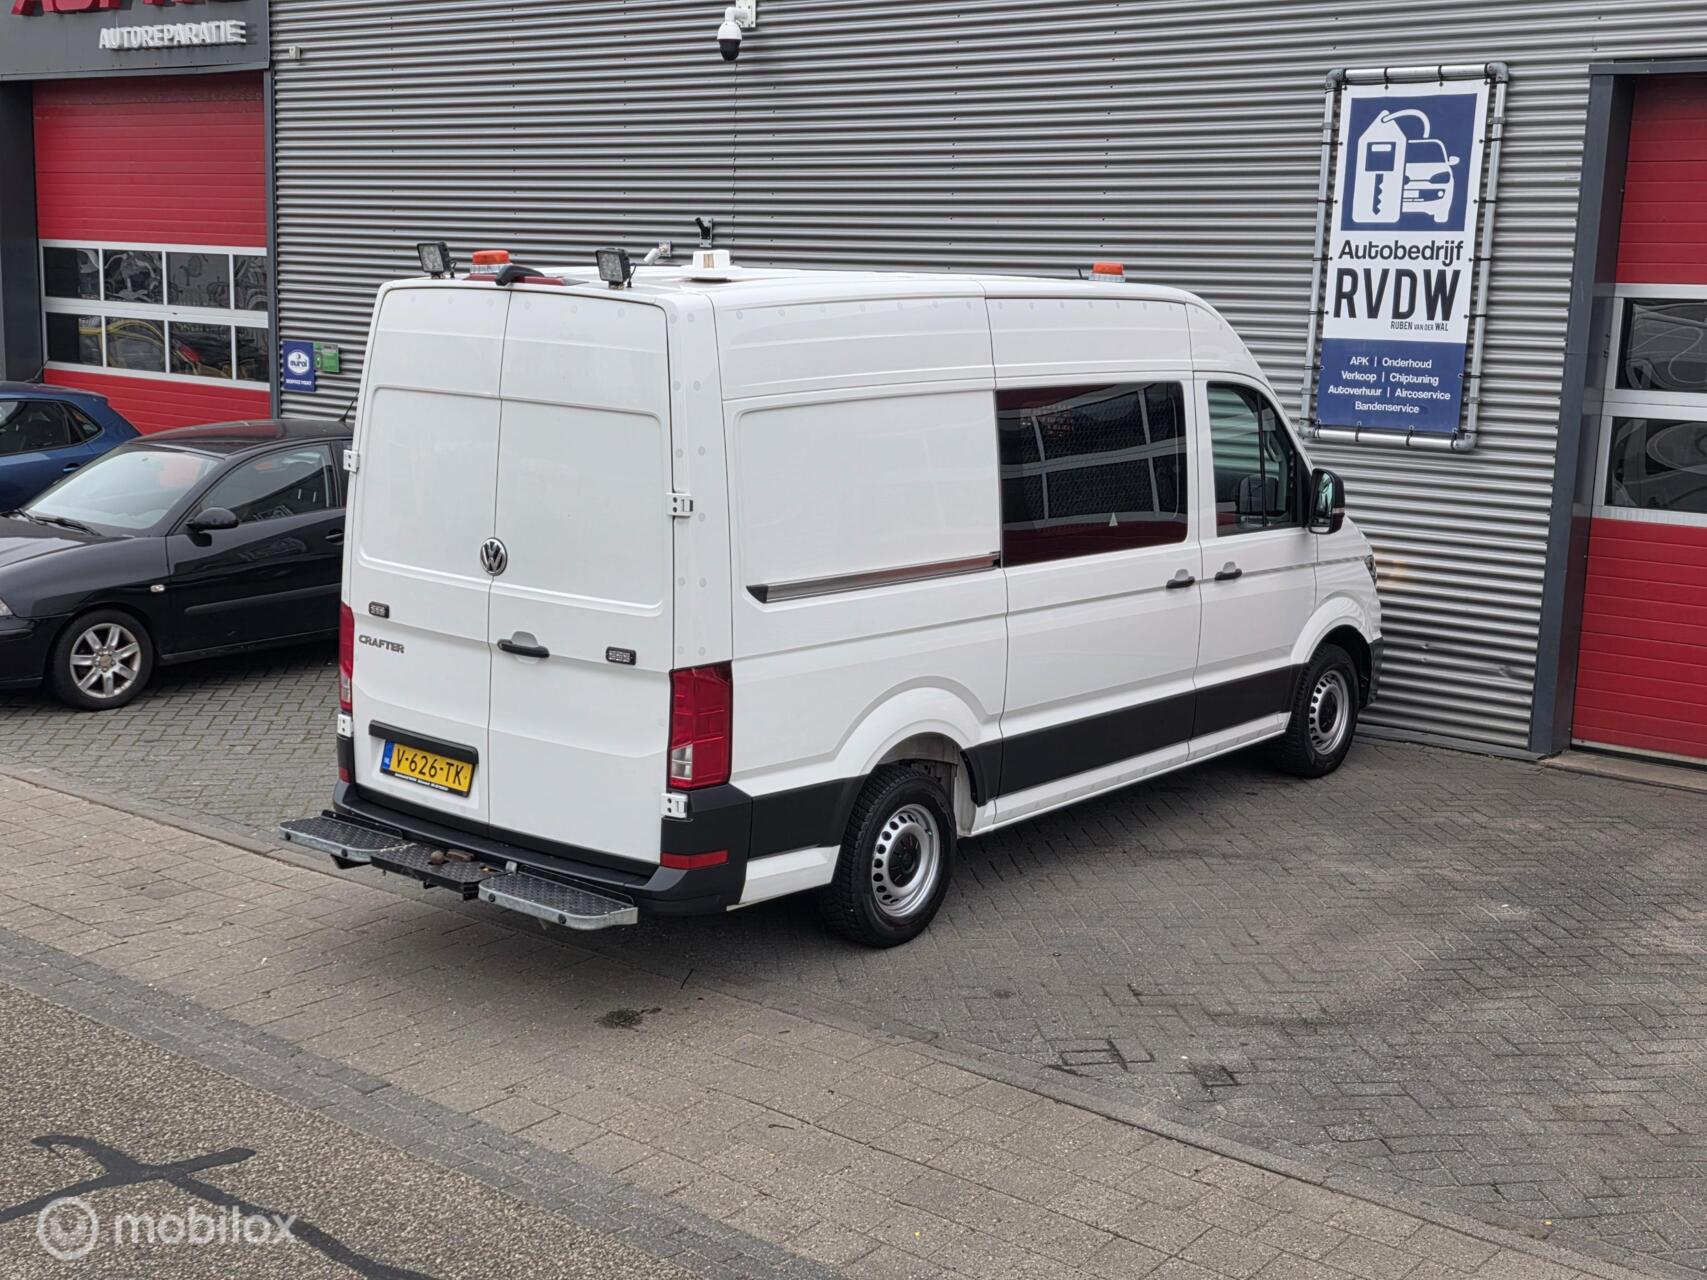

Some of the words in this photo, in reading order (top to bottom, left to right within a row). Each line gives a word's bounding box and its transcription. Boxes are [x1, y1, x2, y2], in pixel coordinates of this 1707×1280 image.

[99, 20, 247, 49] AUTOREPARATIE
[1338, 239, 1463, 267] Autobedrijf
[1333, 267, 1461, 321] RVDW
[1390, 321, 1413, 330] RUBEN
[1414, 323, 1423, 331] VAN
[1424, 323, 1434, 331] DER
[1434, 322, 1449, 332] WAL
[1350, 356, 1369, 366] APK
[1382, 356, 1432, 369] Onderhoud
[1341, 370, 1377, 383] Verkoop
[1389, 372, 1439, 387] Chiptuning
[1328, 384, 1382, 397] Autoverhuur
[1394, 388, 1451, 401] Aircoservice
[1355, 401, 1420, 414] Bandenservice
[358, 634, 405, 654] CRAFTER
[397, 748, 465, 786] V-626-TK
